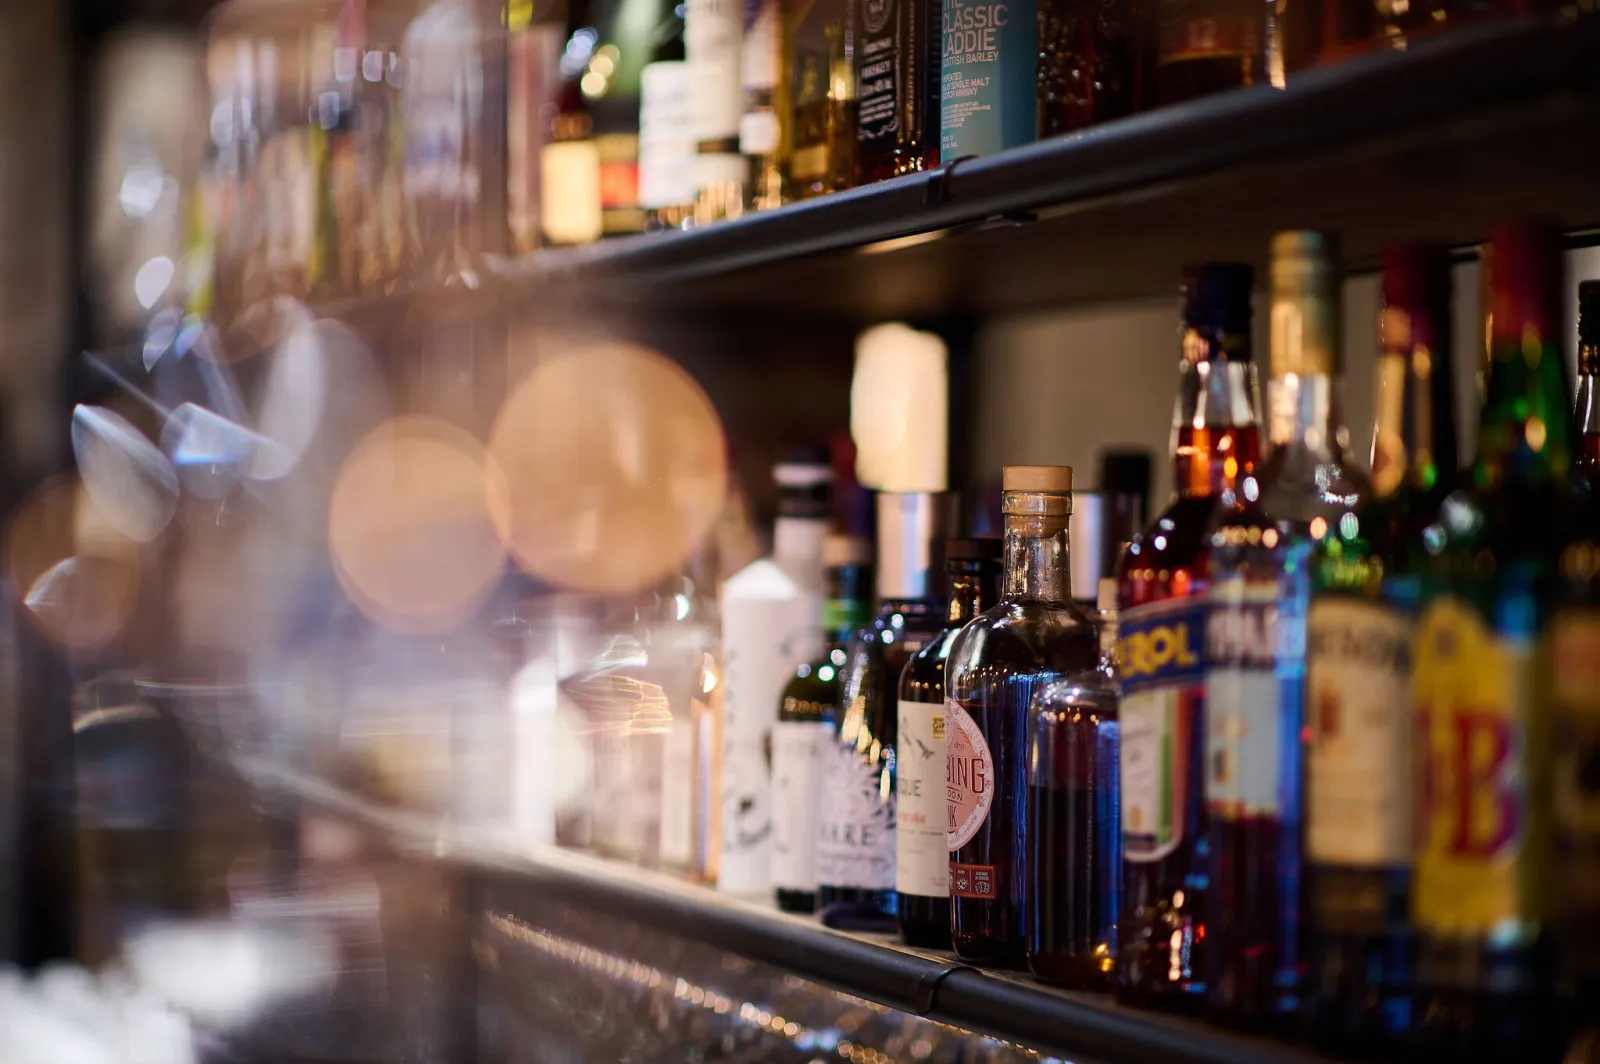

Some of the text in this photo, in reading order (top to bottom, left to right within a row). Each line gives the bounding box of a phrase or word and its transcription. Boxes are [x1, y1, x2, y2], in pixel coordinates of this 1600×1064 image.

[943, 4, 1008, 36] CLASSIC
[942, 28, 997, 58] LADDIE
[966, 51, 1000, 64] BARLEY
[970, 77, 990, 88] MALT
[953, 86, 977, 98] WHISKY
